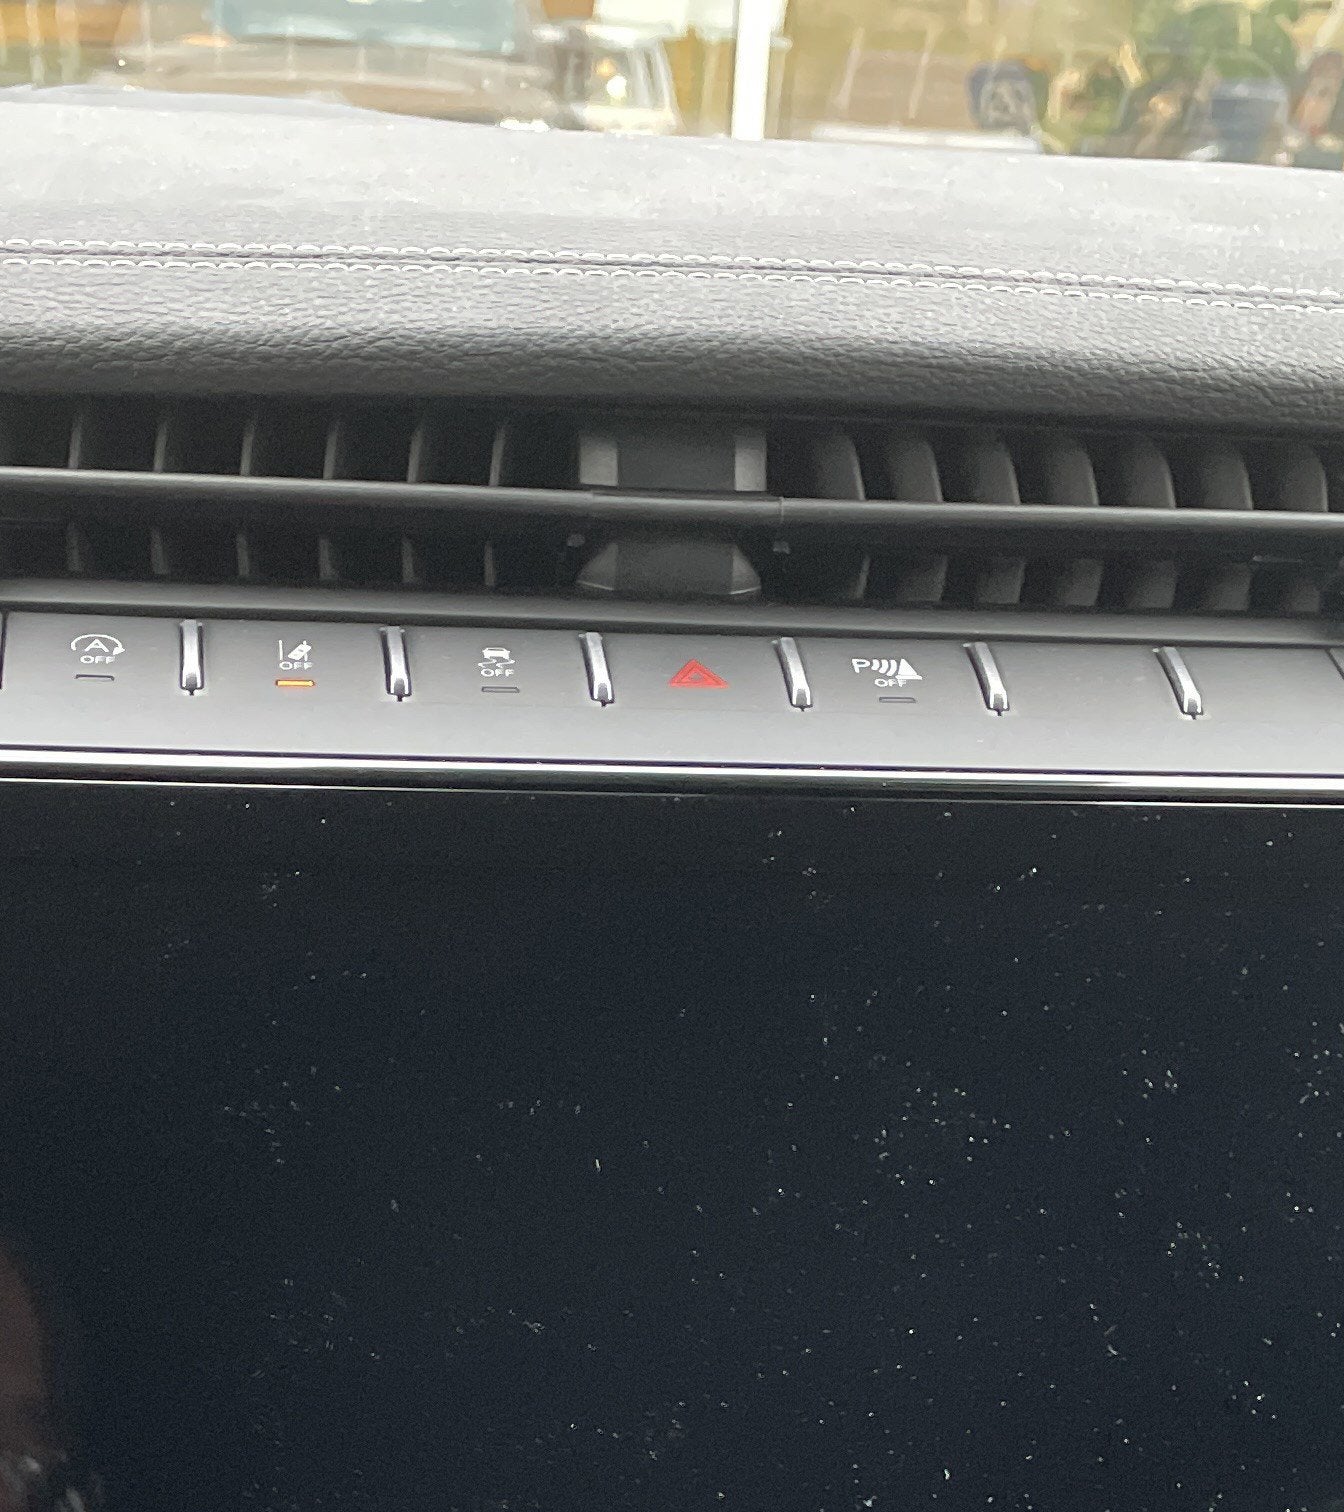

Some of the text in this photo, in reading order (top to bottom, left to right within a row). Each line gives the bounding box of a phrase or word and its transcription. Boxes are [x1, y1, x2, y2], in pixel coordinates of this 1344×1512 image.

[80, 655, 116, 665] OFF
[278, 660, 313, 671] OFF
[480, 668, 515, 678] OFF
[874, 678, 907, 688] OFF
